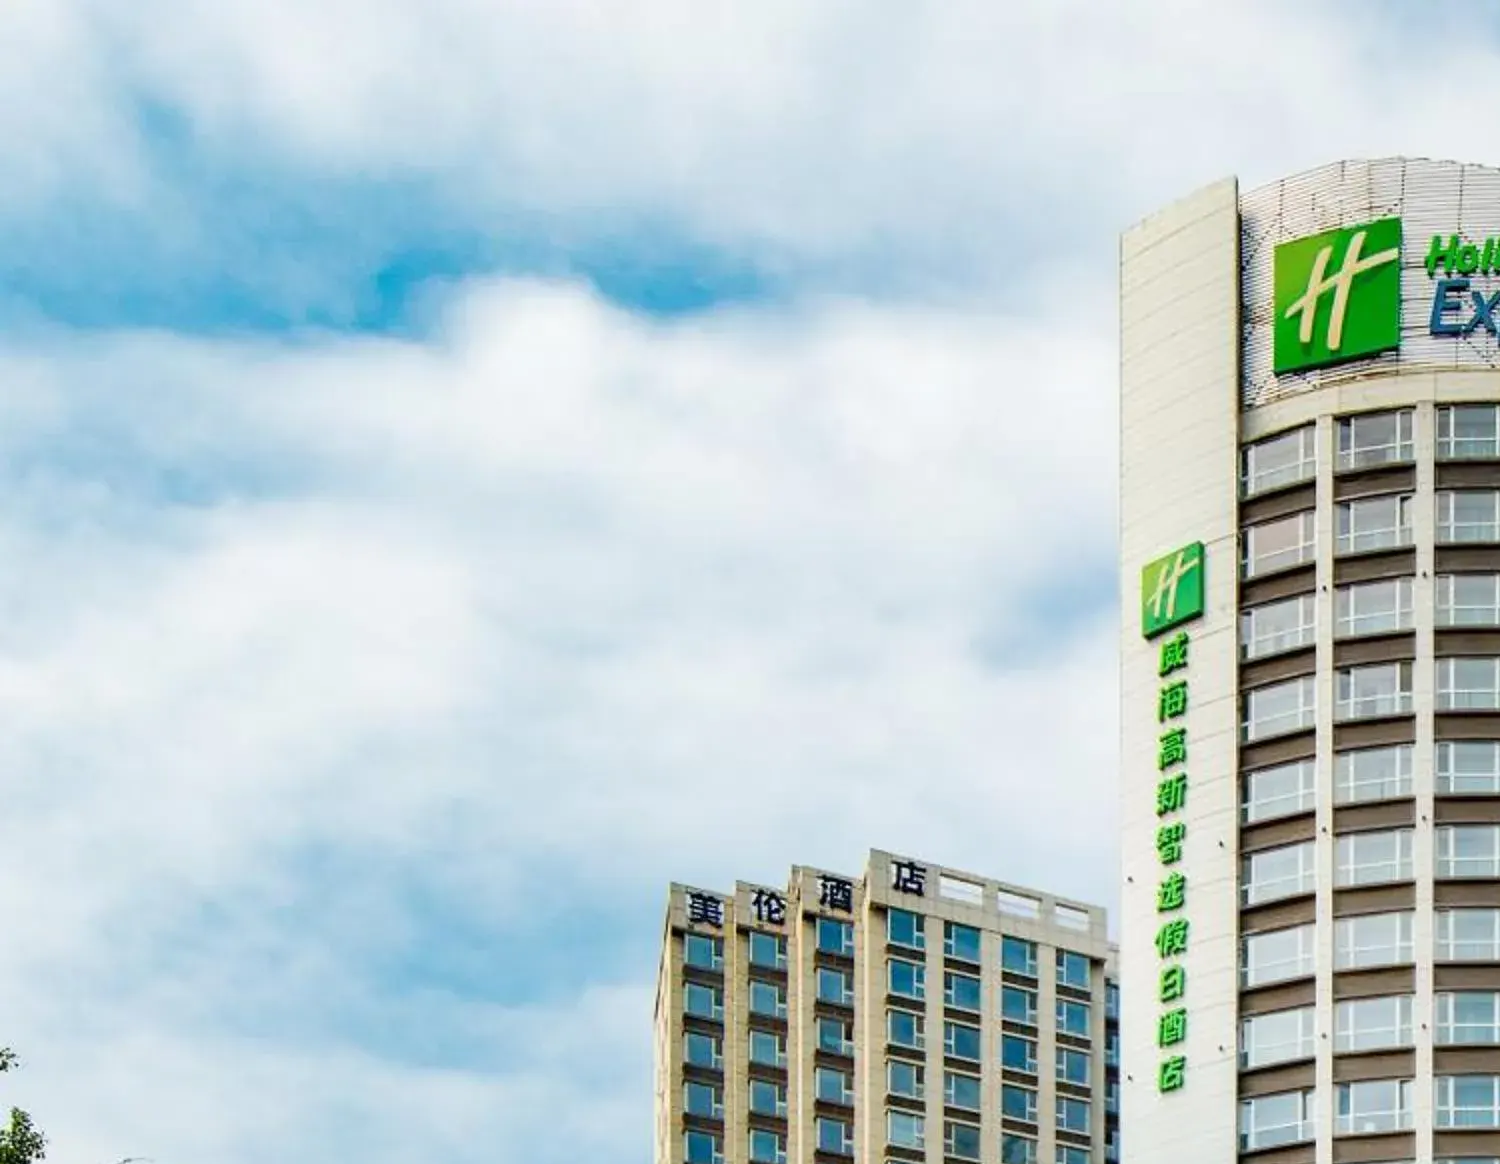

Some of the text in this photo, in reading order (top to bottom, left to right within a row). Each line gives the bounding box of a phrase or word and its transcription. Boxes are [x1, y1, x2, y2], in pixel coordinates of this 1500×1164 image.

[1155, 631, 1190, 1094] 威海高新智选假日酒店
